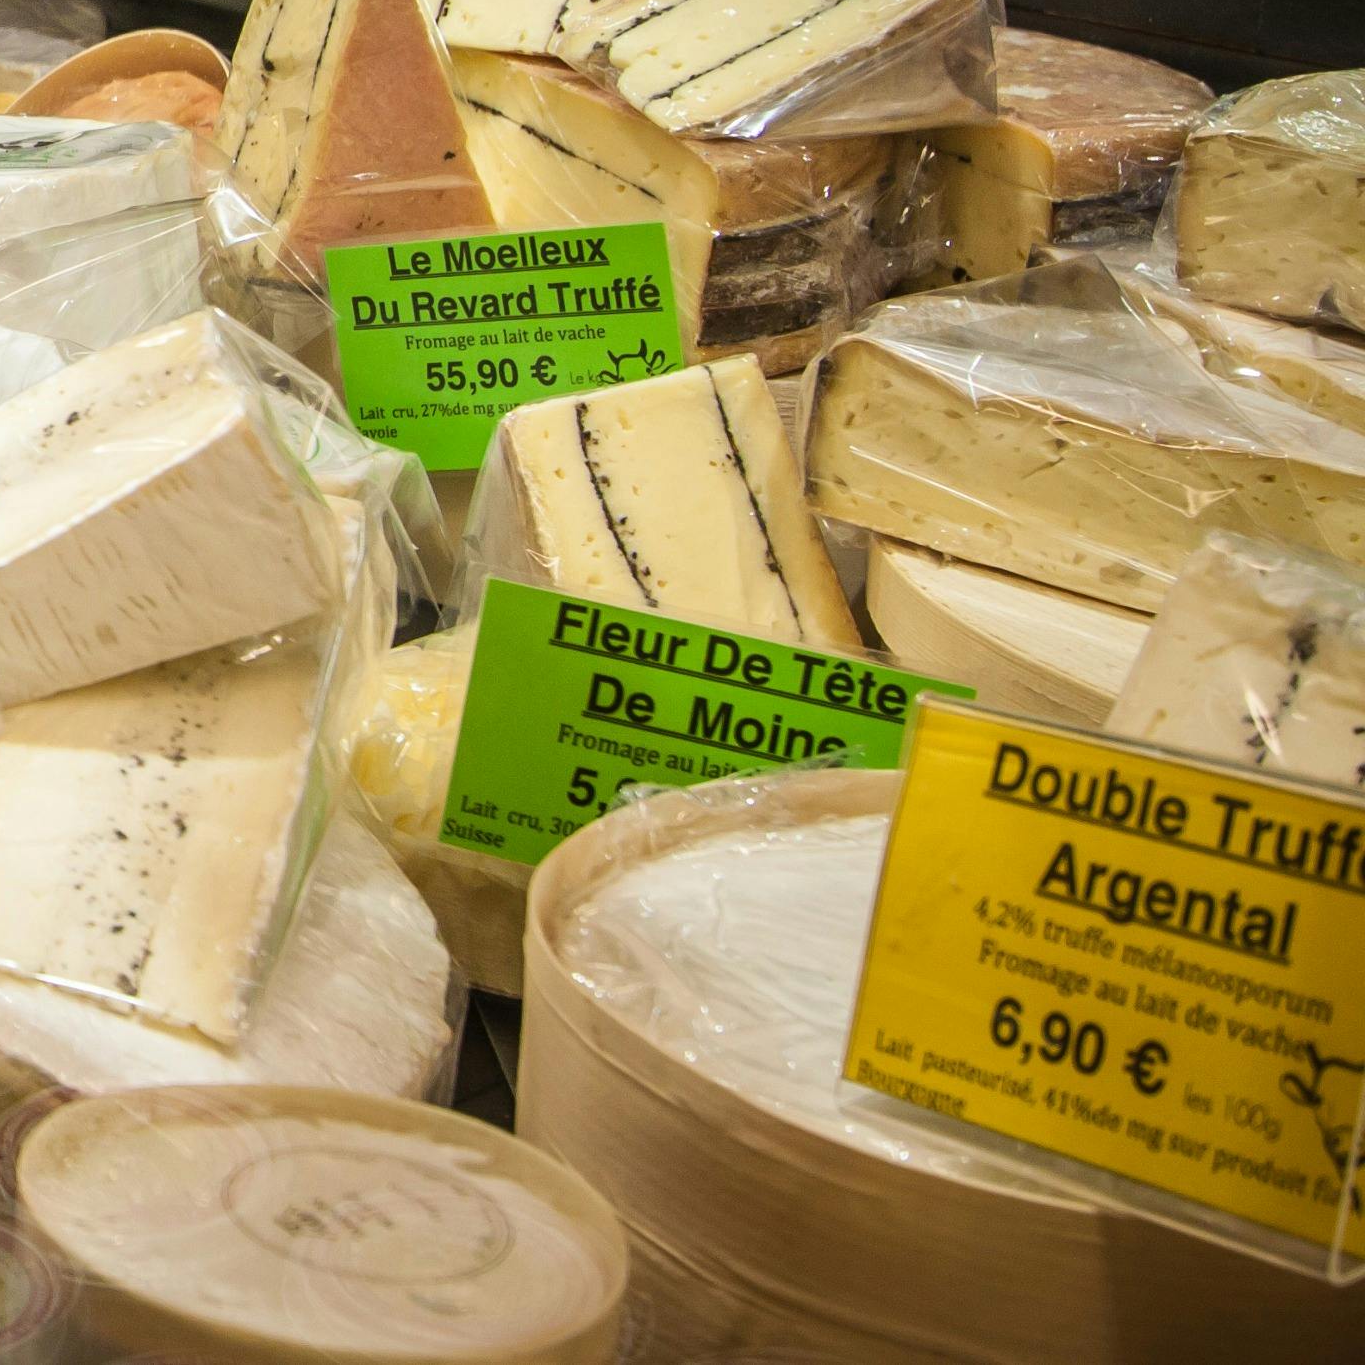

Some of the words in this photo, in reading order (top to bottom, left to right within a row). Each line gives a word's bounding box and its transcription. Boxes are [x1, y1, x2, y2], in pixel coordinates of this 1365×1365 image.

[388, 246, 432, 276] Le
[442, 235, 609, 272] Moelleux
[351, 295, 401, 326] Du
[411, 284, 538, 323] Revard
[547, 274, 662, 313] Truffé
[404, 333, 476, 351] Fromage
[480, 334, 500, 346] au
[503, 328, 530, 345] lait
[534, 326, 554, 342] de
[558, 324, 607, 341] vache
[360, 406, 386, 421] Lait
[392, 407, 419, 420] cru,
[421, 401, 469, 419] 27%de
[473, 403, 496, 418] mg
[426, 358, 520, 396] 55,90
[530, 354, 558, 387] €
[552, 601, 689, 666] Fleur
[703, 634, 773, 686] De
[792, 652, 908, 716] Tête
[557, 722, 660, 767] Fromage
[664, 754, 694, 774] au
[585, 672, 655, 725] De
[687, 696, 848, 766] Moine
[460, 795, 499, 820] Lait
[506, 808, 544, 833] cru,
[989, 742, 1188, 836] Double
[443, 817, 506, 848] Suisse
[1038, 841, 1299, 956] Argental
[977, 937, 1092, 997] Fromage
[1094, 977, 1128, 1007] au
[1134, 985, 1178, 1022] lait
[1184, 1003, 1218, 1034] de
[1225, 1017, 1308, 1062] vache
[1043, 918, 1117, 959] truffe
[1121, 941, 1334, 1026] mélanosporum
[990, 995, 1106, 1076] 6,90
[1123, 1039, 1169, 1095] €
[874, 1028, 915, 1063] Lait
[1126, 1118, 1164, 1154] mg
[1168, 1134, 1208, 1161] sur
[1211, 1147, 1309, 1196] produit
